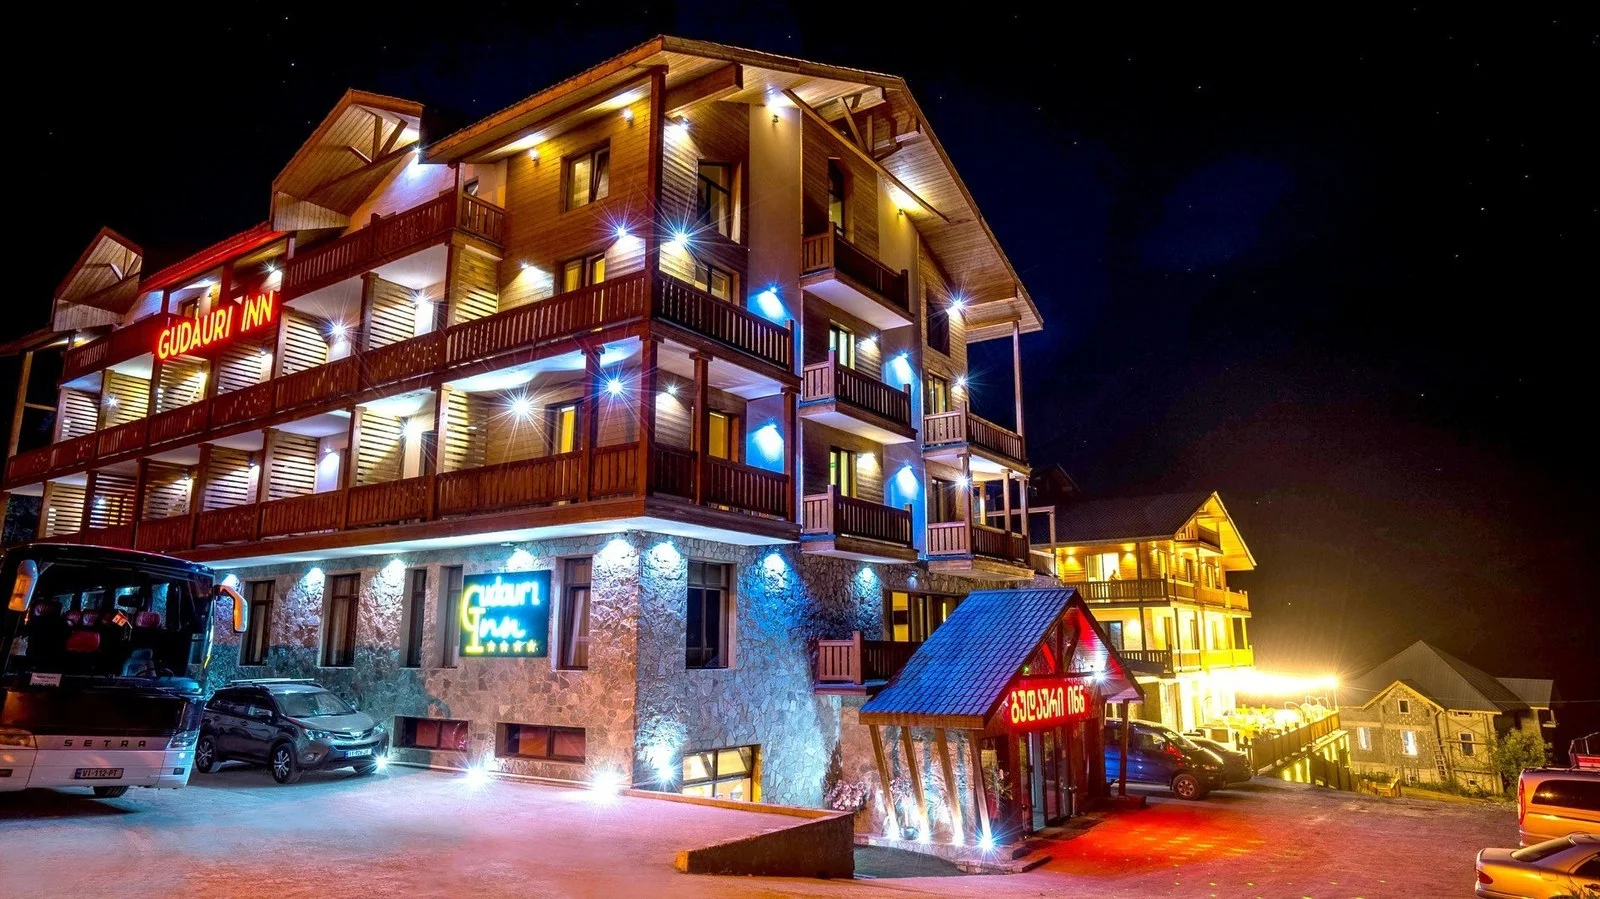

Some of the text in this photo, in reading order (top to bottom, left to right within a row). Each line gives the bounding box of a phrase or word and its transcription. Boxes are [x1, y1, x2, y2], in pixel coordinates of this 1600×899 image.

[157, 289, 274, 360] GUDAURI INN
[462, 575, 541, 654] Gudauri Inn
[1011, 684, 1086, 724] გუდაური ინნ
[63, 739, 147, 748] SETRA
